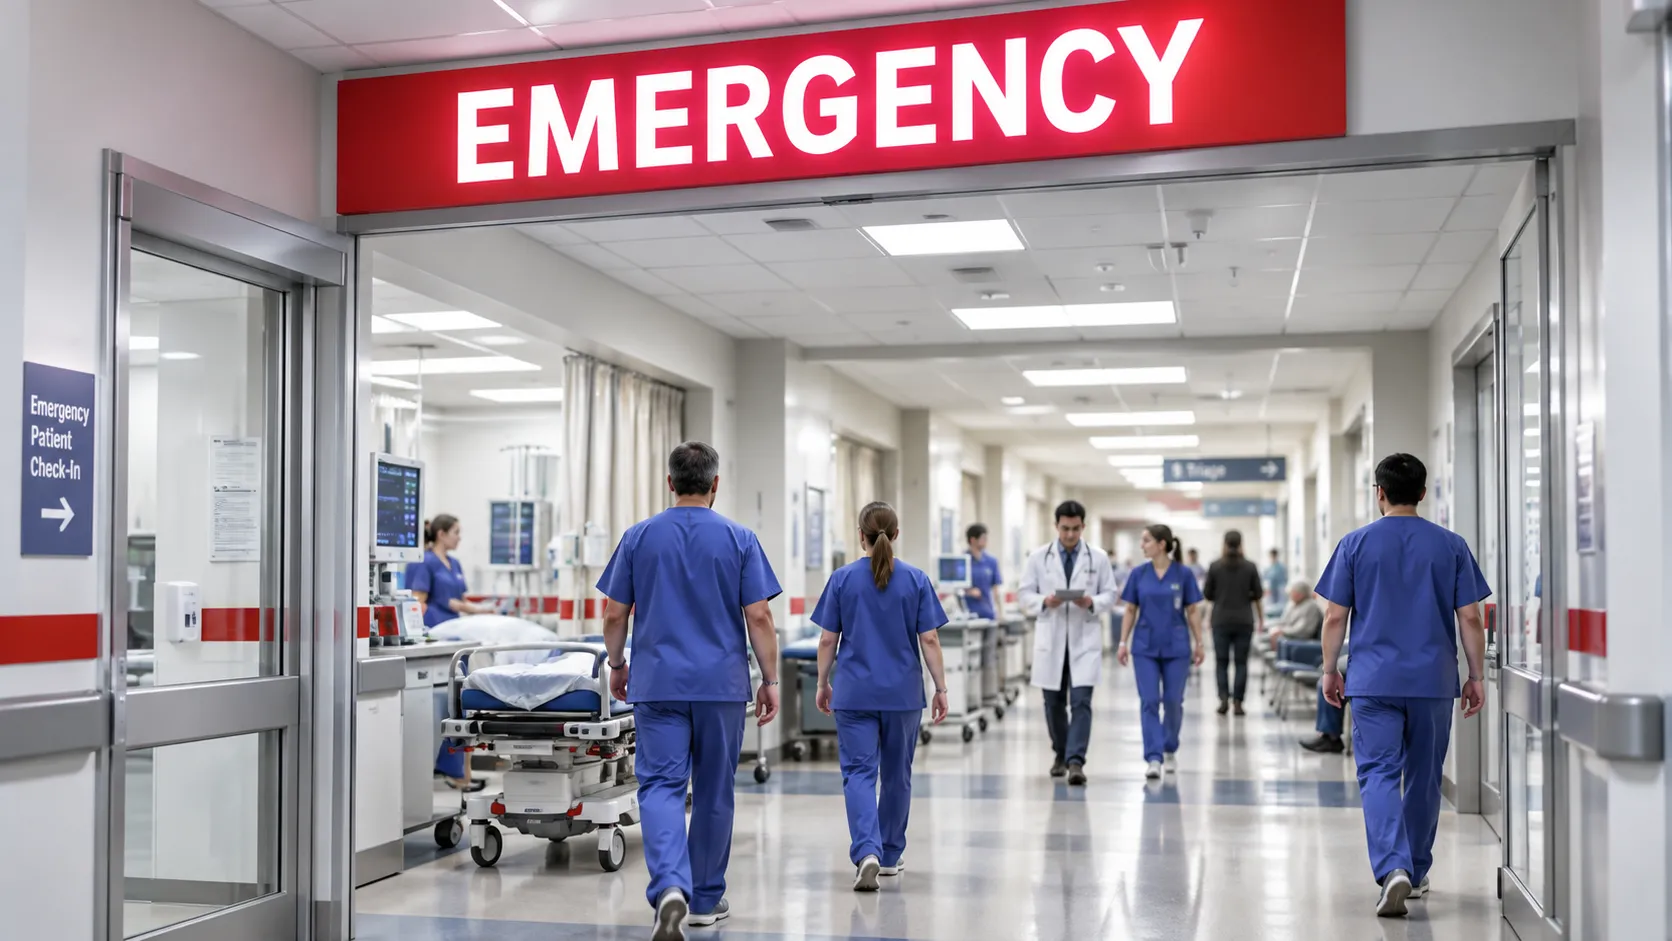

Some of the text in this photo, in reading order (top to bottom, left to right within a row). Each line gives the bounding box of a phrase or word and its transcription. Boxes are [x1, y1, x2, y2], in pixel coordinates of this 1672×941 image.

[456, 18, 1204, 184] EMERGENCY
[31, 394, 90, 427] Emergency
[31, 425, 72, 450] Patient
[1186, 462, 1227, 480] Triage
